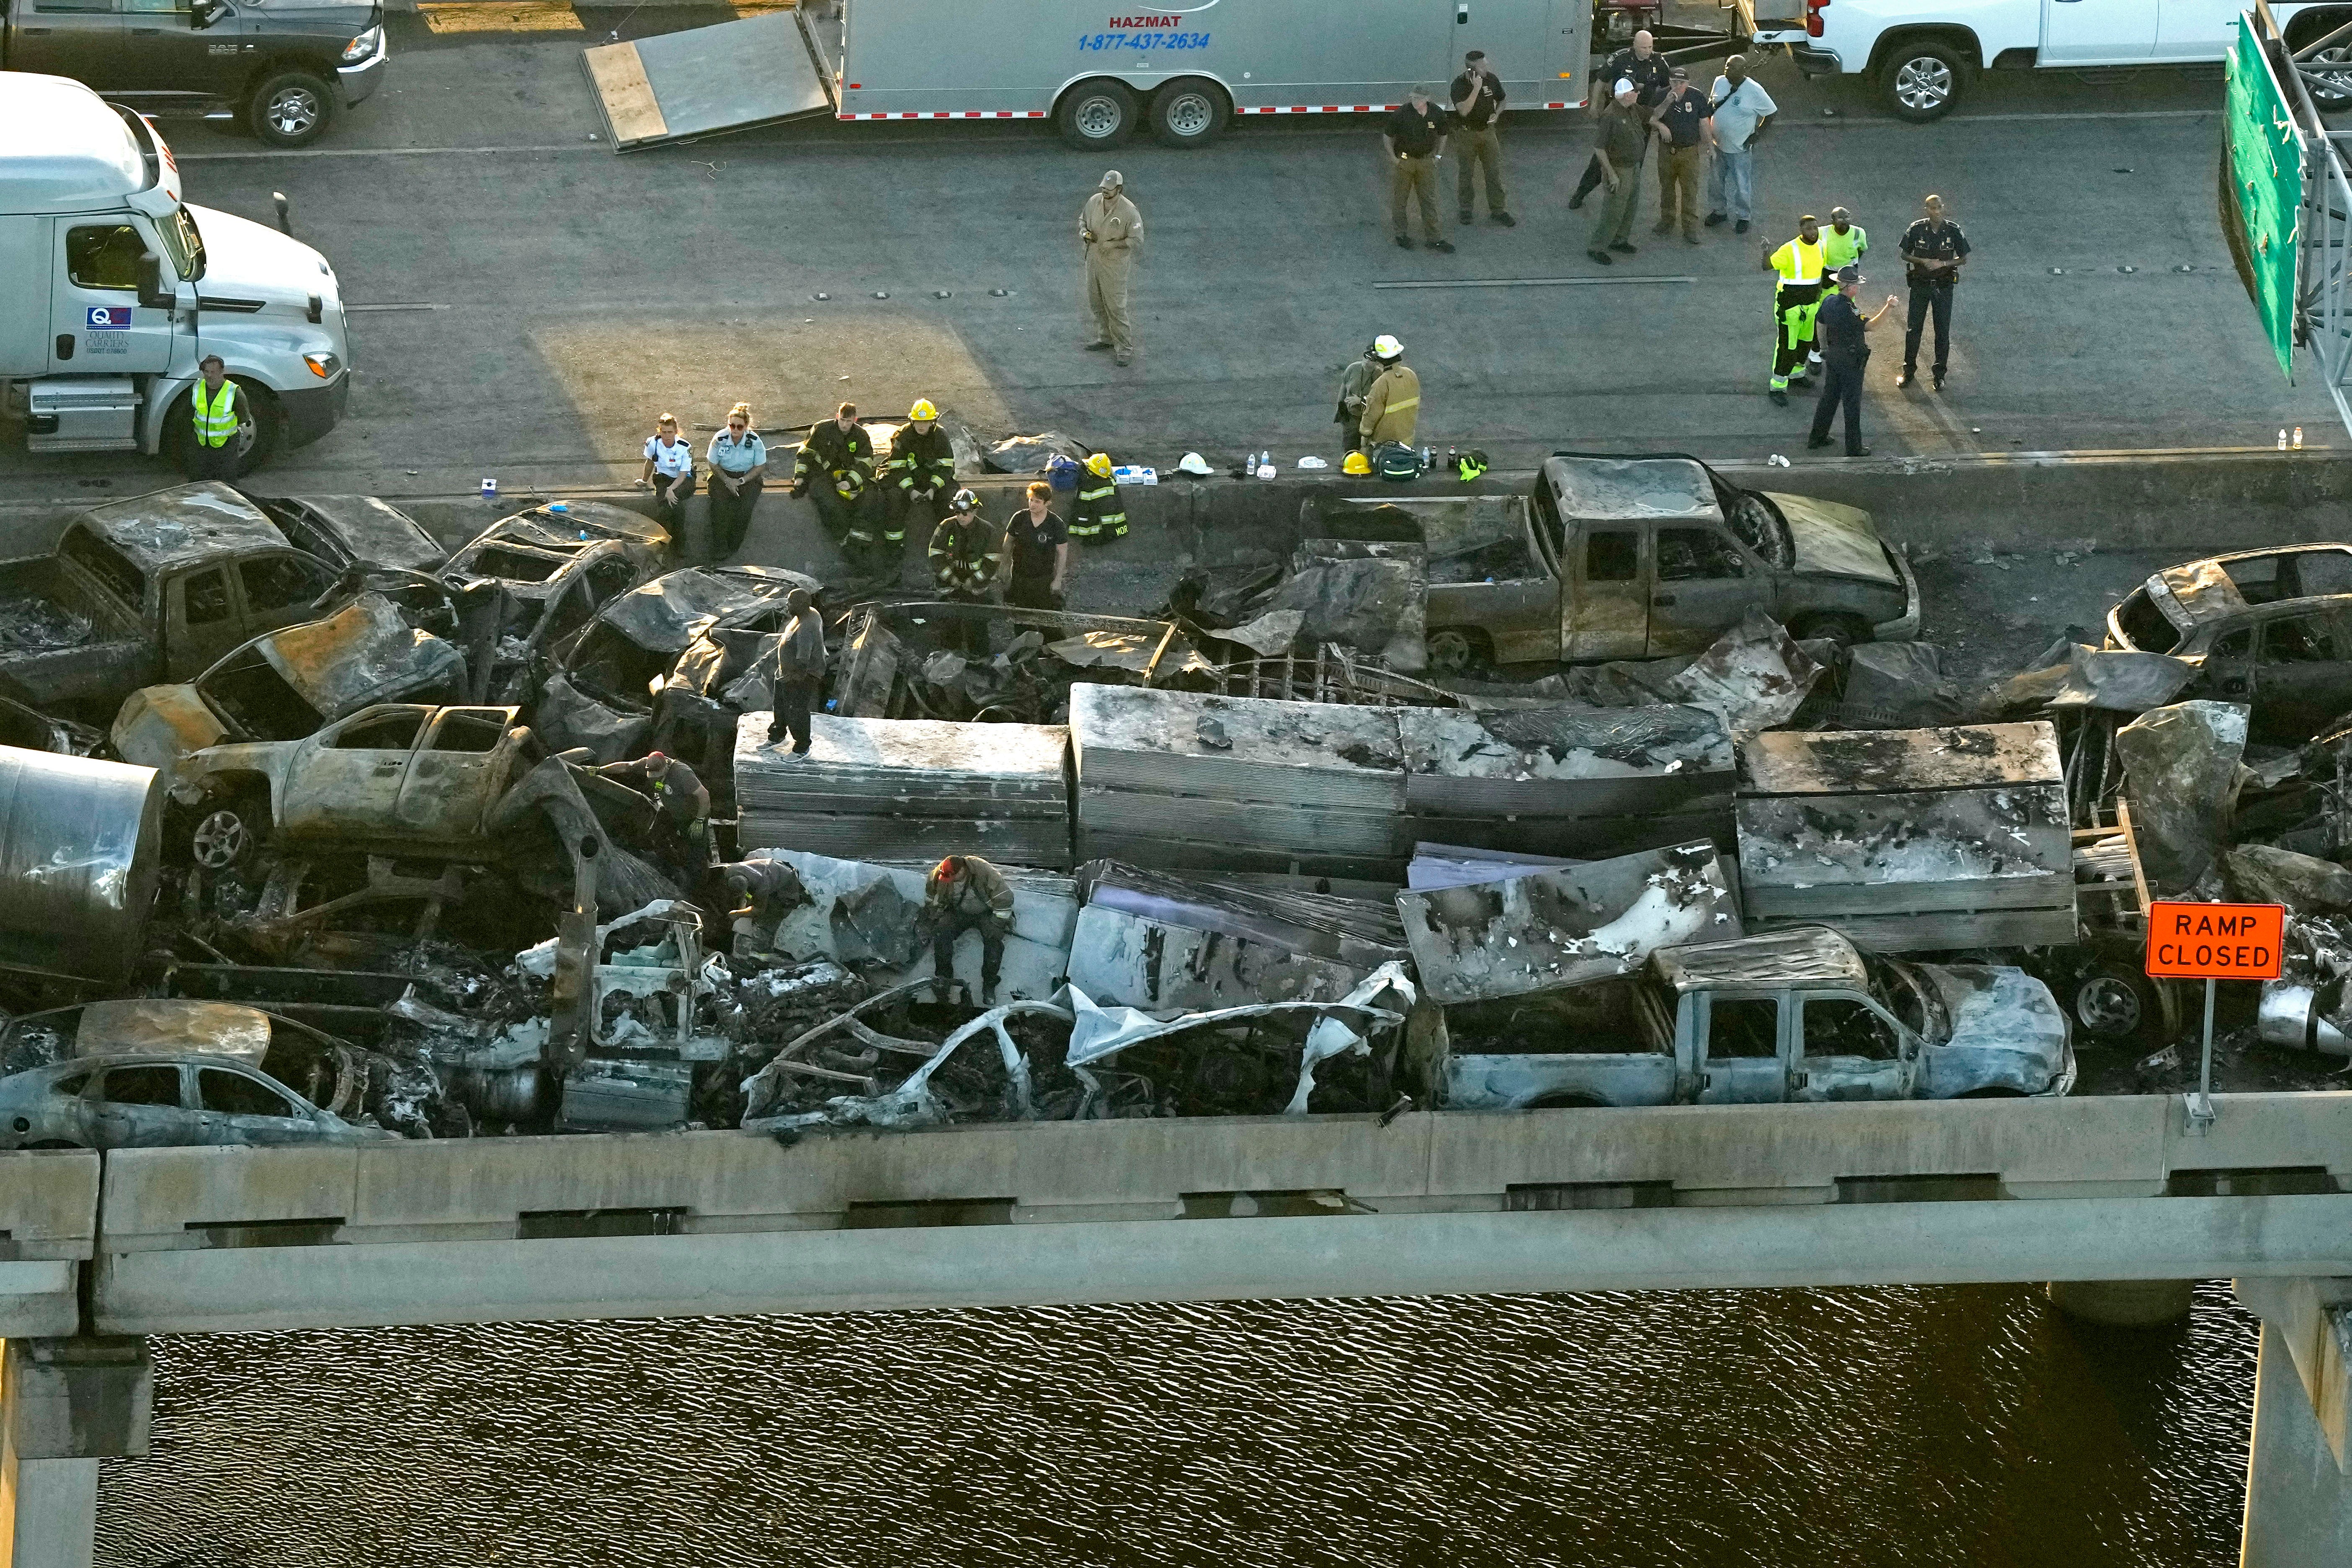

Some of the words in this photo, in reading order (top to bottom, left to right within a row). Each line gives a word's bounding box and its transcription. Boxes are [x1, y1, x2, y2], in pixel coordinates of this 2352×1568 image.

[1110, 16, 1182, 28] HAZMAT
[1079, 33, 1210, 50] 1-877-437-2634
[85, 339, 129, 348] CARRIERS
[2175, 914, 2257, 937] RAMP
[2158, 944, 2269, 967] CLOSED
